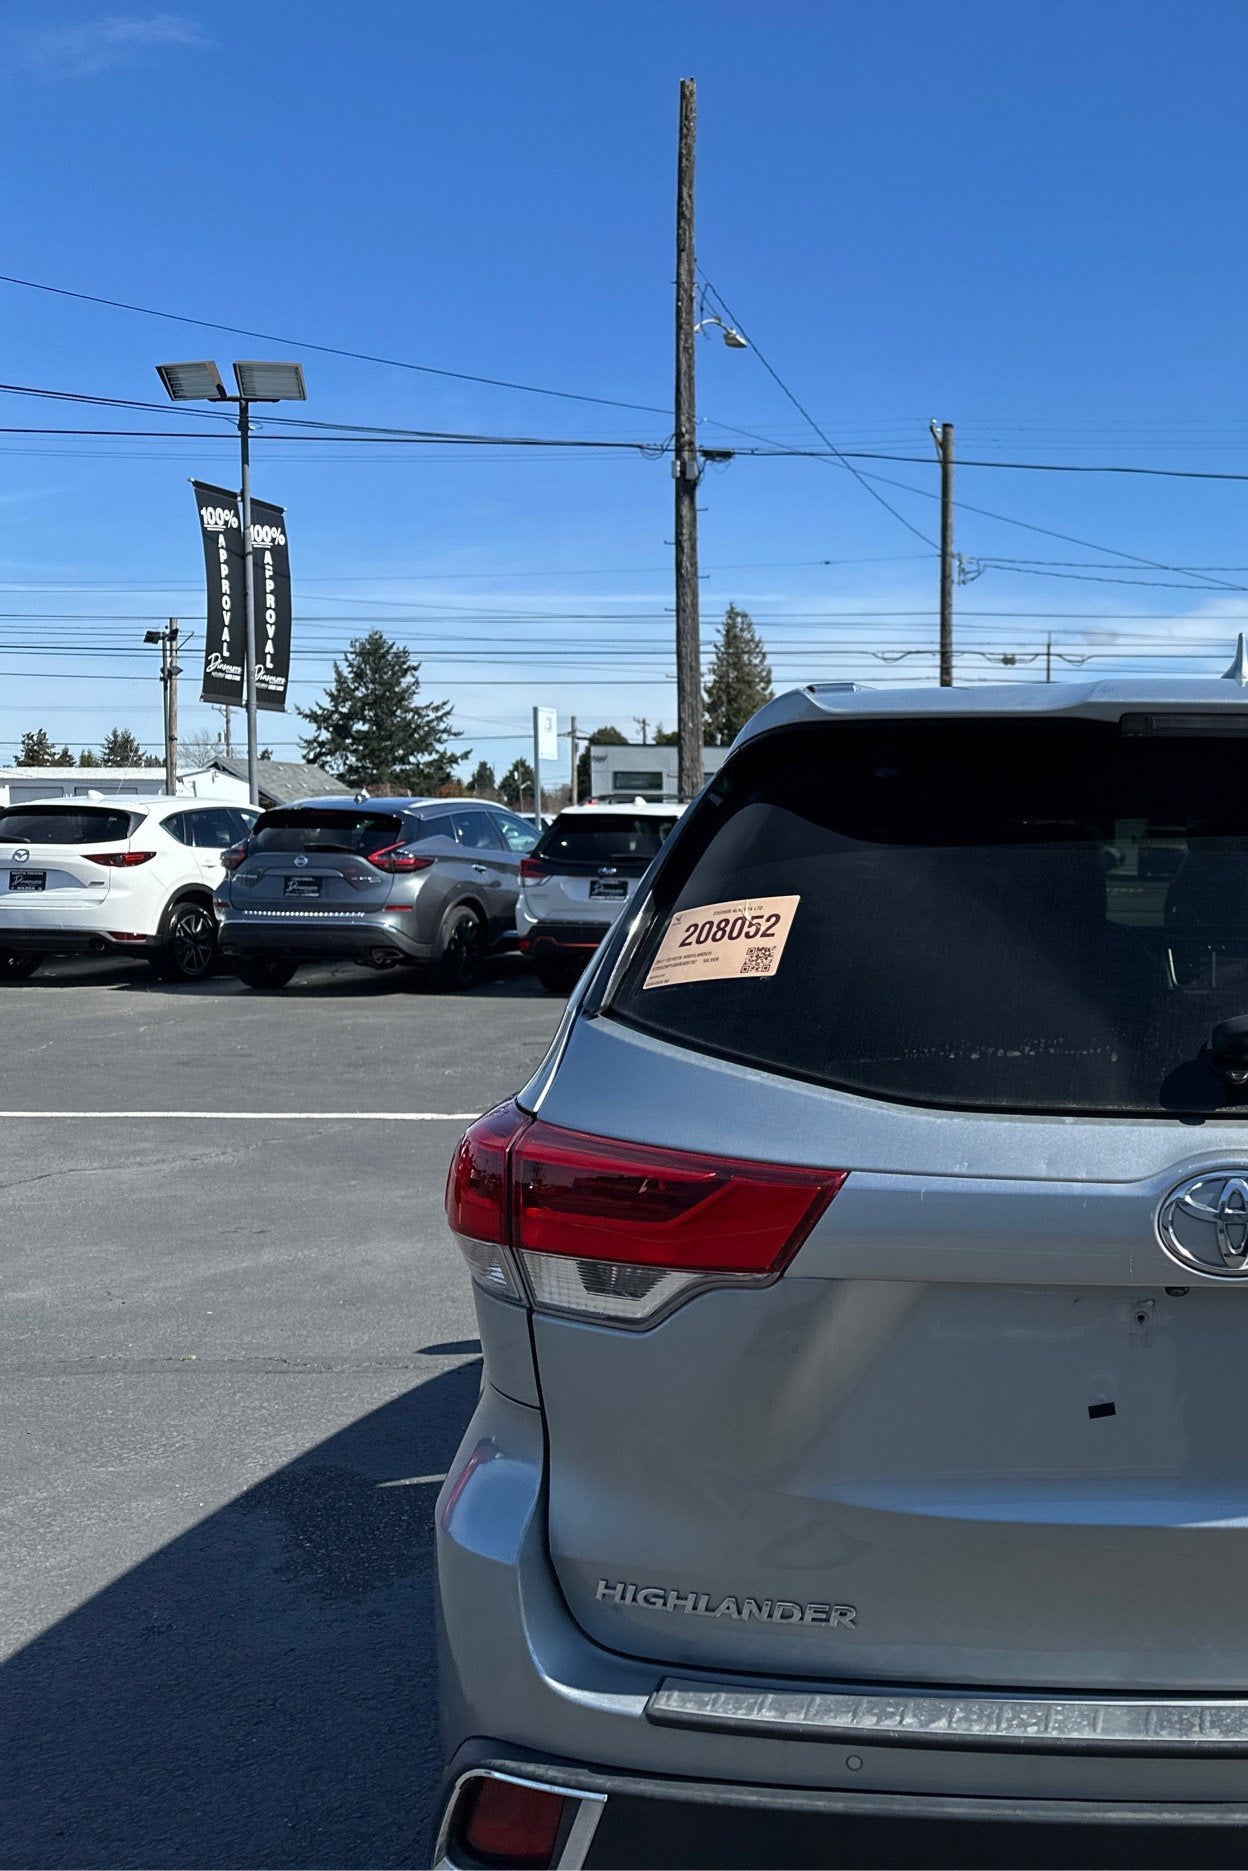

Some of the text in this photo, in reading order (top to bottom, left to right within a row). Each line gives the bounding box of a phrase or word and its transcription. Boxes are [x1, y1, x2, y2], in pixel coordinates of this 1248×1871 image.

[200, 506, 239, 529] 100%
[249, 524, 286, 546] 100%
[216, 534, 231, 657] APPROVAL
[263, 550, 275, 669] APPROVAL
[679, 913, 782, 949] 208052
[595, 1580, 858, 1630] HIGHLANDER
